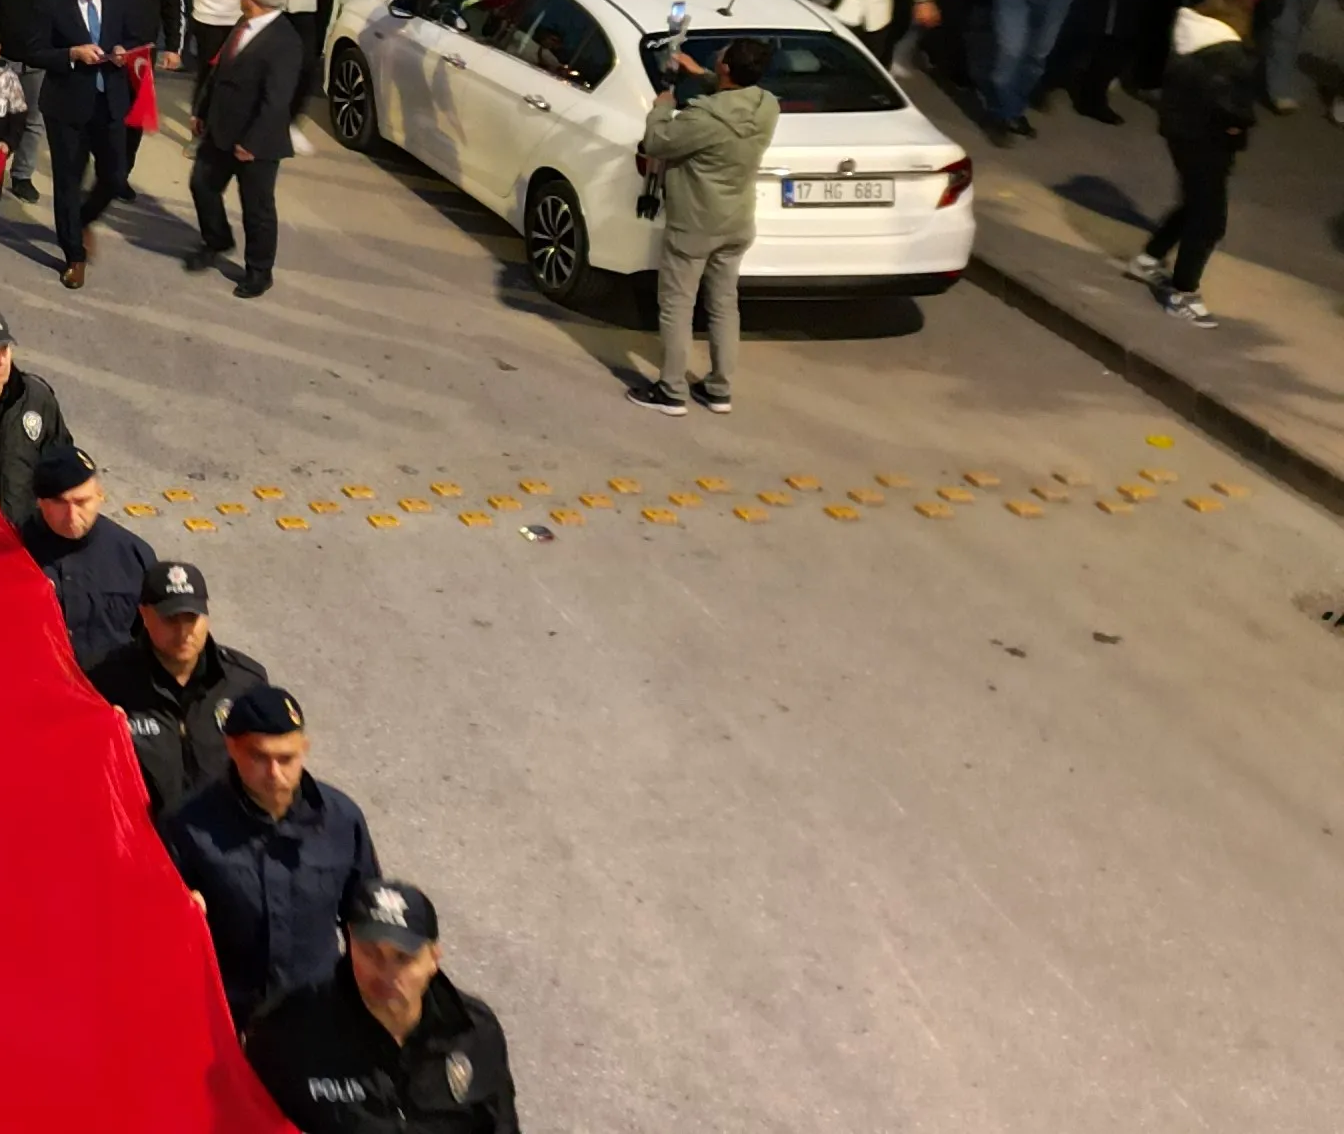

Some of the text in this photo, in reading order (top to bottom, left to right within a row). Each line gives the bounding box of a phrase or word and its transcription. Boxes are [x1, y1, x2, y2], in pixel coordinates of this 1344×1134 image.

[797, 182, 882, 199] 17 HG 683
